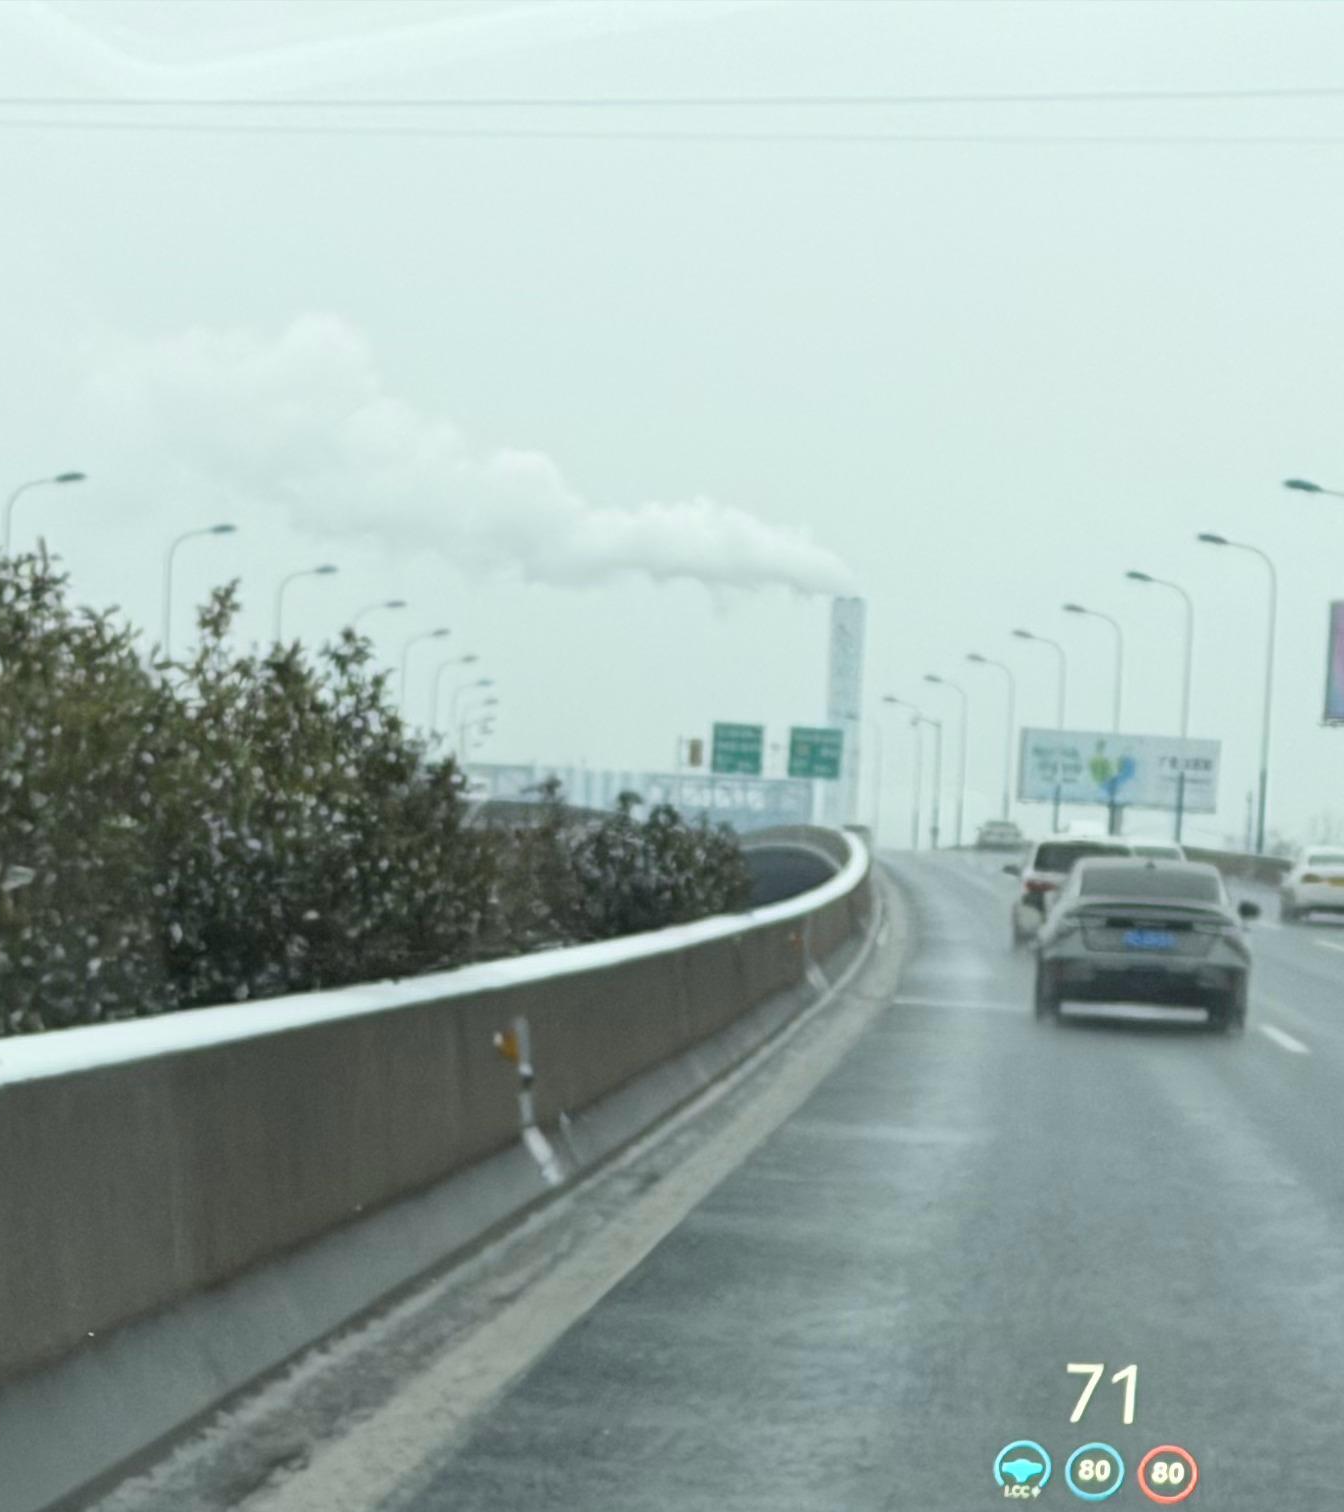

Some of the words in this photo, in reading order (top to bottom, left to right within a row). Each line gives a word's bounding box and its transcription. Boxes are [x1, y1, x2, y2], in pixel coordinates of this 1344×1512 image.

[1066, 1362, 1138, 1425] 71
[1078, 1459, 1111, 1482] 80
[1151, 1462, 1185, 1485] 80
